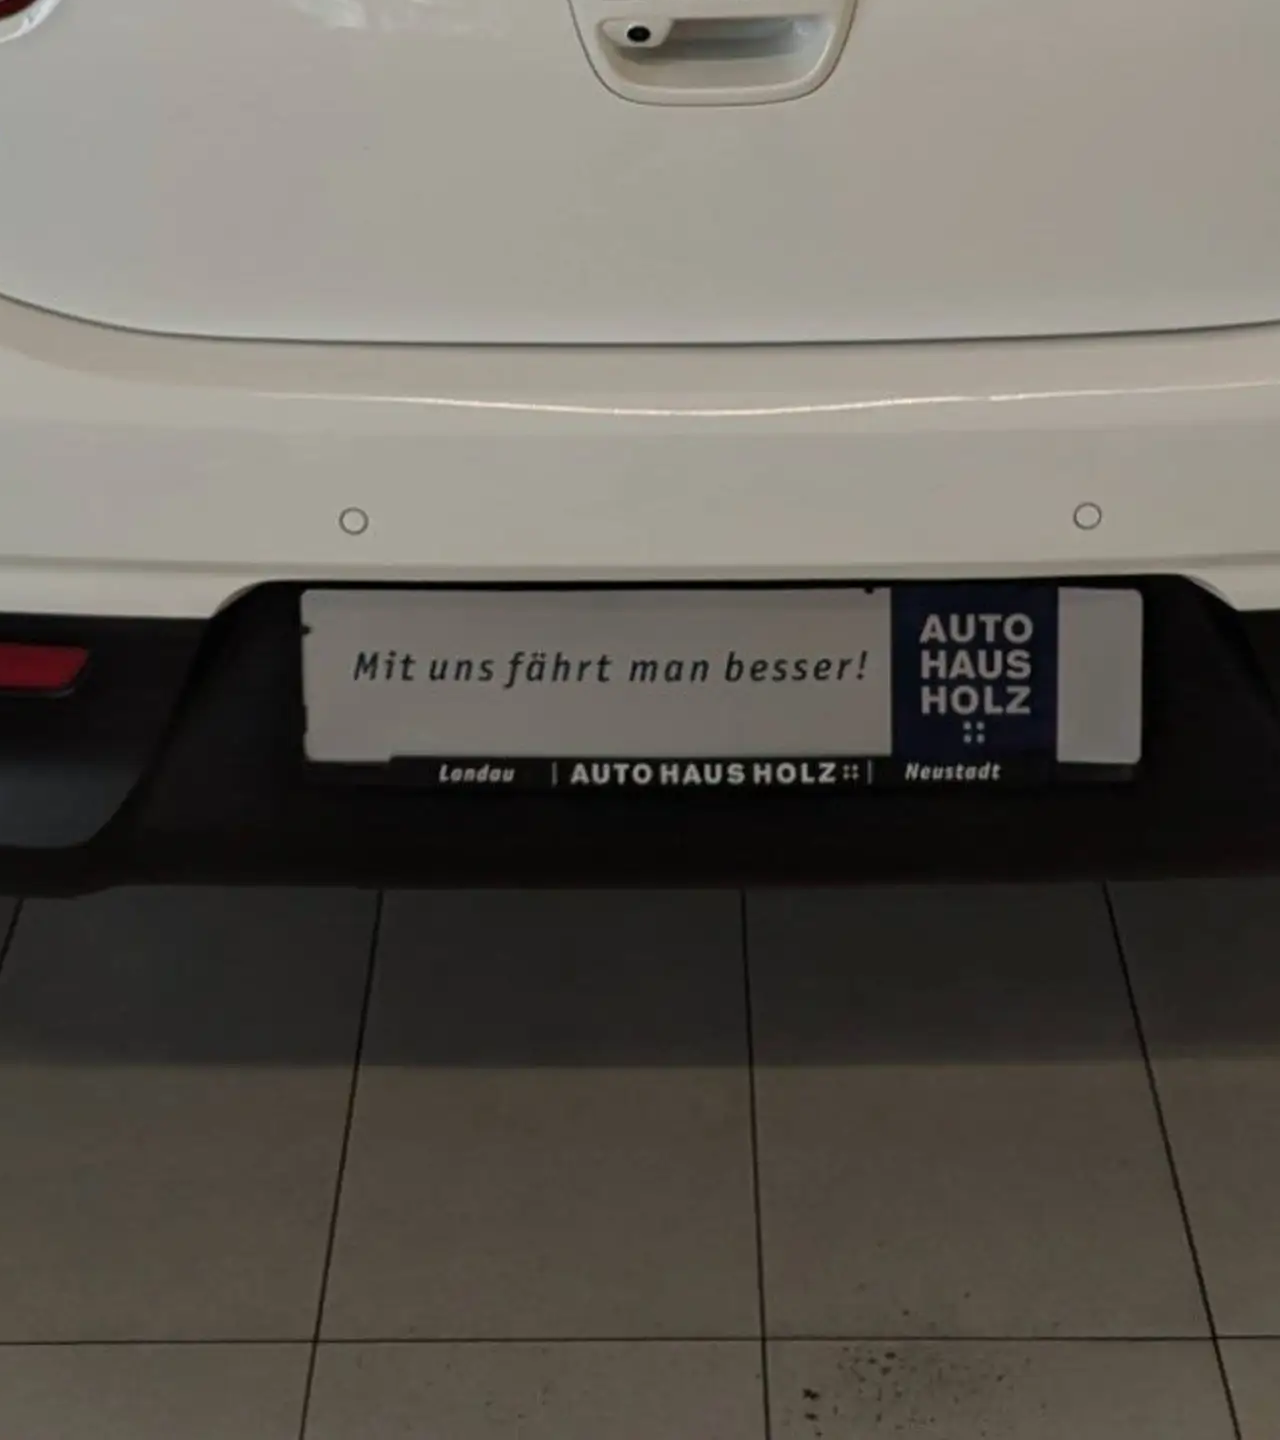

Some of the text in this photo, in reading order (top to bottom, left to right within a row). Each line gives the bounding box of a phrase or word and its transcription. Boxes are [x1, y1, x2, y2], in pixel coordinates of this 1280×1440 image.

[919, 613, 1033, 644] AUTO
[354, 650, 868, 690] Mit uns fährt man besser!
[921, 649, 1032, 680] HAUS
[921, 685, 1031, 715] HOLZ
[438, 763, 515, 783] Landau
[753, 762, 837, 785] HOLZ
[905, 762, 1001, 782] Neustadt
